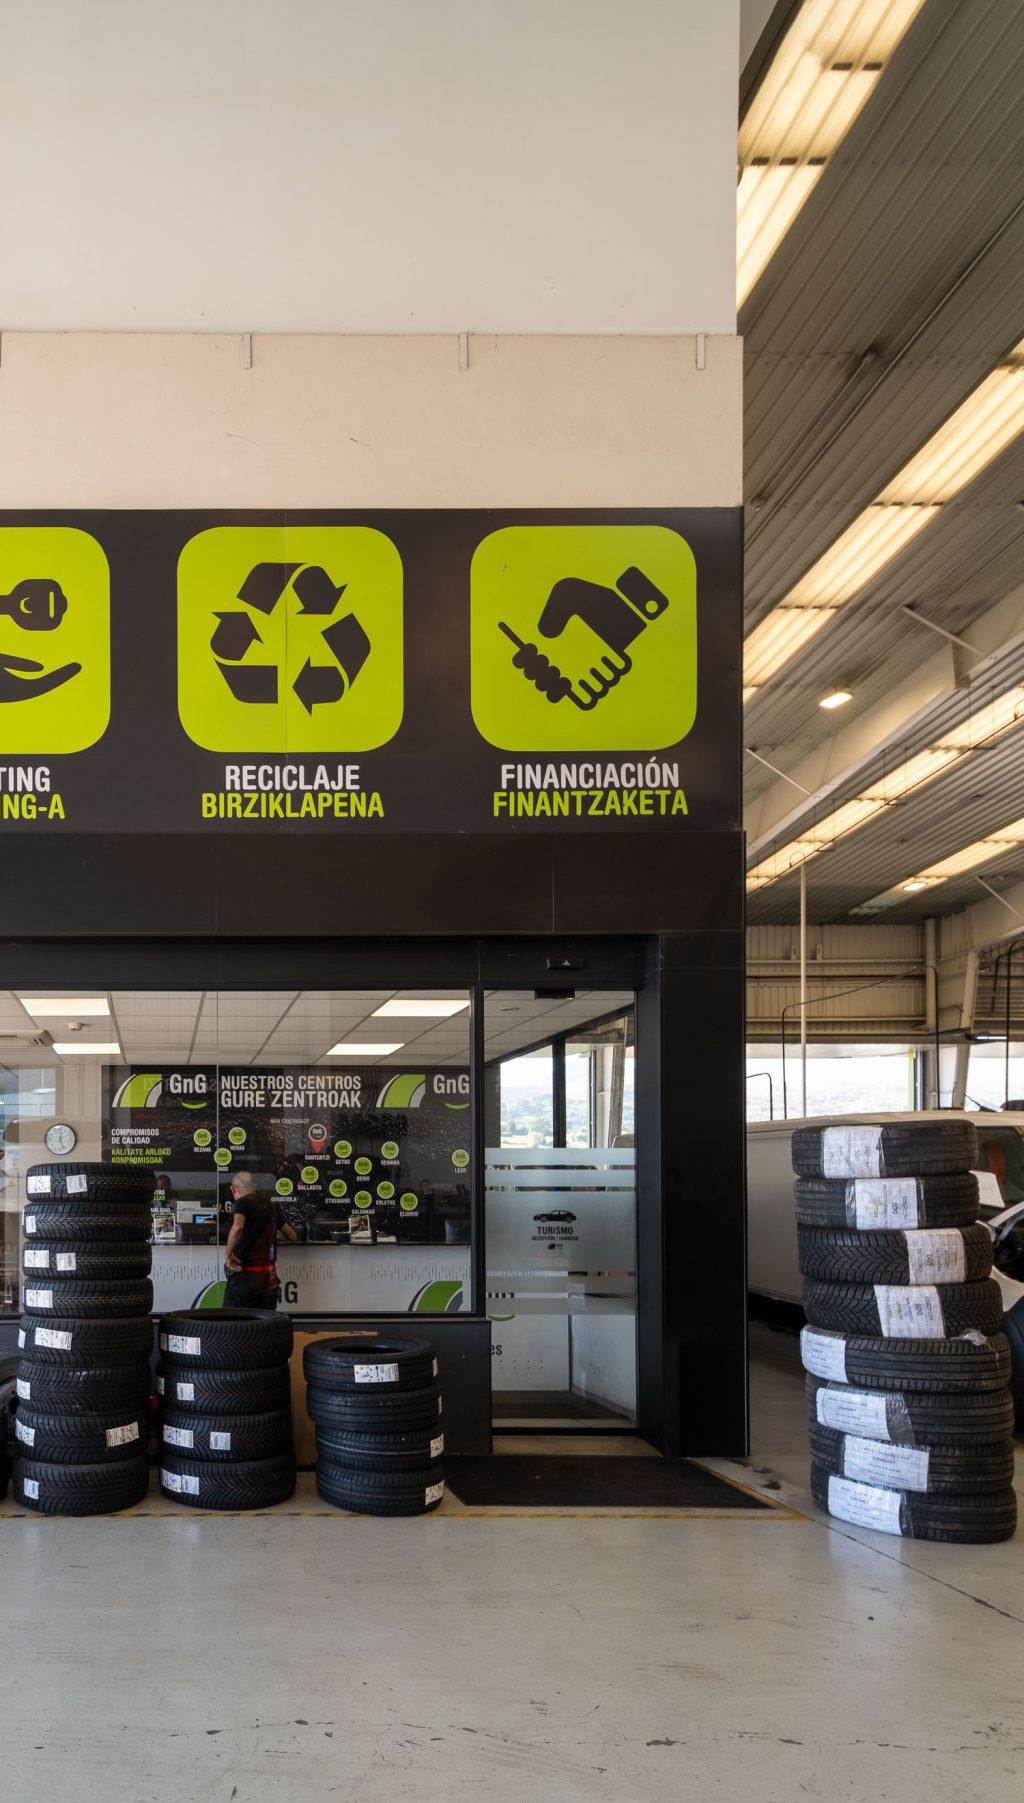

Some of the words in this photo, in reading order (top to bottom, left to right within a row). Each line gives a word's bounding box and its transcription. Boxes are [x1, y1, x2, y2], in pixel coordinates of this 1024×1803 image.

[225, 765, 360, 791] RECICLAJE
[501, 757, 679, 790] FINANCIACIÓN
[201, 793, 385, 818] BIRZIKLAPENA
[493, 790, 689, 817] FINANTZAKETA
[170, 1074, 207, 1094] GnG
[221, 1076, 293, 1090] NUESTROS
[298, 1076, 361, 1090] CENTROS
[433, 1074, 470, 1094] GnG
[221, 1091, 265, 1108] GURE
[271, 1091, 361, 1108] ZENTROAK
[111, 1128, 159, 1136] COMPROMISOS
[111, 1148, 143, 1156] KALITATE
[145, 1148, 171, 1156] ARLOKO
[537, 1226, 573, 1235] TURISMO
